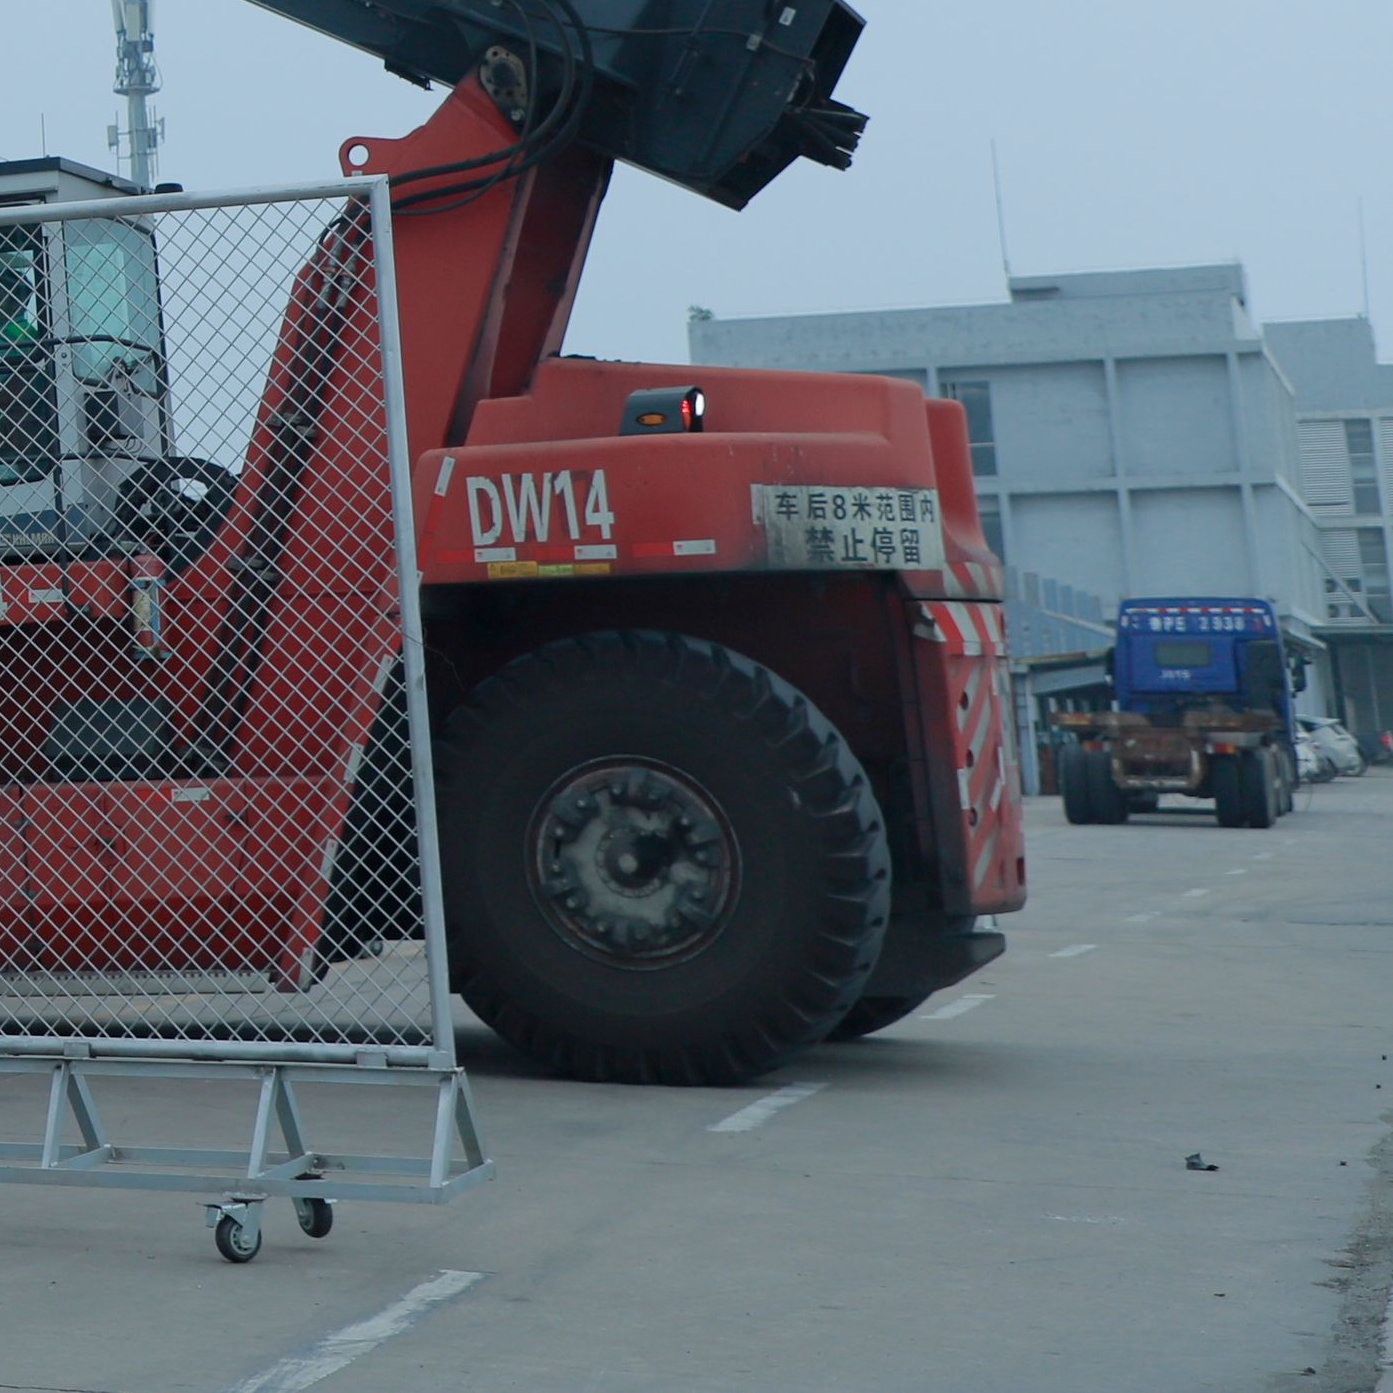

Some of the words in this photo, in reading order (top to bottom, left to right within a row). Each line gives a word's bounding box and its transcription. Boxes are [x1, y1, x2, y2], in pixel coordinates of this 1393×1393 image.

[465, 469, 616, 547] DW14
[774, 492, 935, 524] 车后8米范围内
[805, 526, 922, 565] 禁止停留
